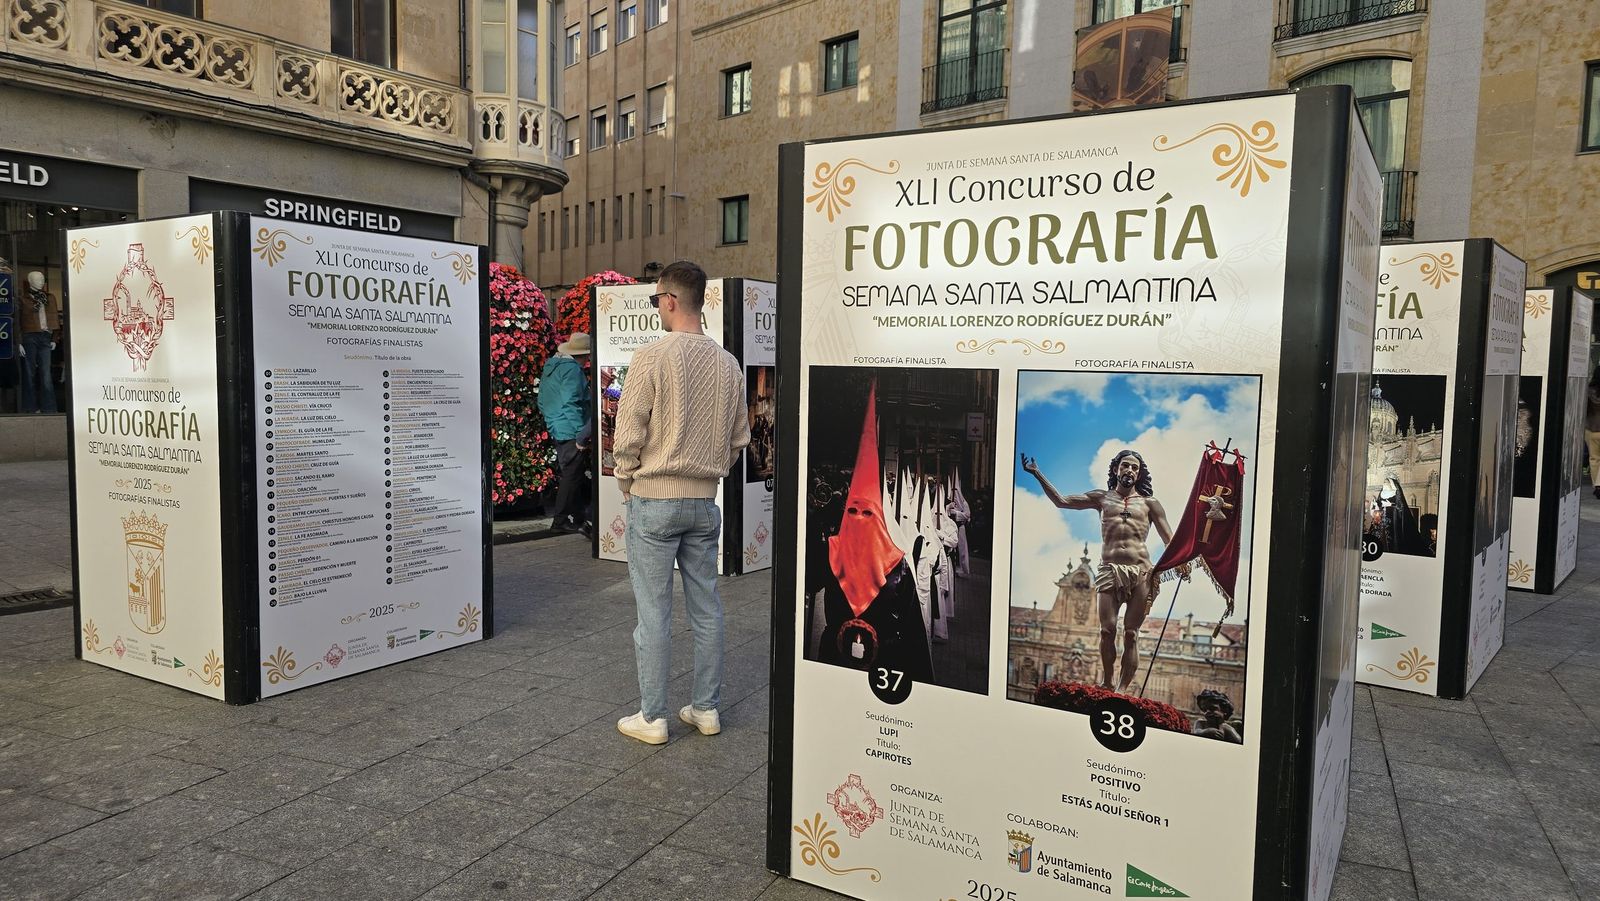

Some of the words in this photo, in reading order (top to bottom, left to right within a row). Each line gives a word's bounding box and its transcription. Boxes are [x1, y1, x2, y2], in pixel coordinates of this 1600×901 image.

[926, 161, 954, 171] JUNTA
[956, 160, 967, 169] DE
[969, 157, 1008, 168] SEMANA
[1009, 153, 1040, 164] SANTA
[1042, 152, 1055, 161] DE
[1057, 146, 1119, 161] SALAMANCA
[895, 177, 937, 207] XLI
[949, 171, 1102, 204] Concurso
[1113, 161, 1155, 192] de
[265, 198, 401, 232] SPRINGFIELD
[845, 192, 1218, 272] FOTOGRAFÍA
[315, 250, 338, 267] XLI
[343, 253, 410, 274] Concurso
[413, 261, 428, 275] de
[288, 270, 451, 307] FOTOGRAFÍA
[842, 284, 938, 307] SEMANA
[944, 282, 1024, 305] SANTA
[1032, 277, 1217, 304] SALMANTINA
[288, 304, 342, 320] SEMANA
[345, 308, 382, 322] SANTA
[385, 310, 452, 325] SALMANTINA
[872, 316, 947, 327] “MEMORIAL
[950, 314, 1014, 327] LORENZO
[1017, 312, 1104, 327] RODRÍGUEZ
[1106, 311, 1172, 327] DURÁN”
[307, 322, 348, 331] “MEMORIAL
[348, 324, 379, 332] LORENZO
[380, 324, 414, 334] RODRÍGUEZ
[414, 326, 438, 334] DURÁN”
[327, 337, 382, 346] FOTOGRAFÍAS
[383, 340, 423, 348] FINALISTAS
[609, 336, 638, 345] SEMANA
[853, 356, 903, 364] FOTOGRAFÍA
[1075, 359, 1139, 368] FOTOGRAFÍA
[1141, 360, 1194, 369] FINALISTA
[102, 385, 116, 401] XLI
[119, 385, 166, 403] Concurso
[168, 387, 181, 403] de
[87, 405, 201, 442] FOTOGRAFÍA
[88, 441, 119, 455] SEMANA
[121, 444, 146, 458] SANTA
[147, 446, 202, 463] SALMANTINA
[133, 478, 152, 490] 2025
[108, 492, 146, 504] FOTOGRAFÍAS
[147, 497, 180, 508] FINALISTAS
[1365, 589, 1392, 597] DORADA
[369, 603, 394, 619] 2025
[876, 667, 904, 692] 37
[865, 710, 913, 728] Seudónimo:
[1100, 710, 1135, 739] 38
[879, 727, 898, 738] LUPI
[876, 738, 900, 750] Título:
[865, 748, 912, 766] CAPIROTES
[1086, 758, 1146, 779] Seudónimo:
[890, 783, 943, 803] ORGANIZA:
[1090, 774, 1141, 792] POSITIVO
[1099, 788, 1130, 804] Título:
[890, 800, 926, 818] JUNTA
[929, 811, 944, 823] DE
[1061, 793, 1093, 809] ESTÁS
[1094, 802, 1122, 816] AQUÍ
[1124, 810, 1161, 825] SEÑOR
[1164, 819, 1169, 827] 1
[889, 813, 937, 835] SEMANA
[940, 825, 980, 846] SANTA
[1007, 812, 1079, 838] COLABORAN:
[890, 826, 904, 837] DE
[907, 830, 982, 860] SALAMANCA
[1036, 850, 1112, 880] Ayuntamiento
[967, 880, 1016, 901] 2025
[1036, 865, 1050, 876] de
[1052, 869, 1112, 895] Salamanca
